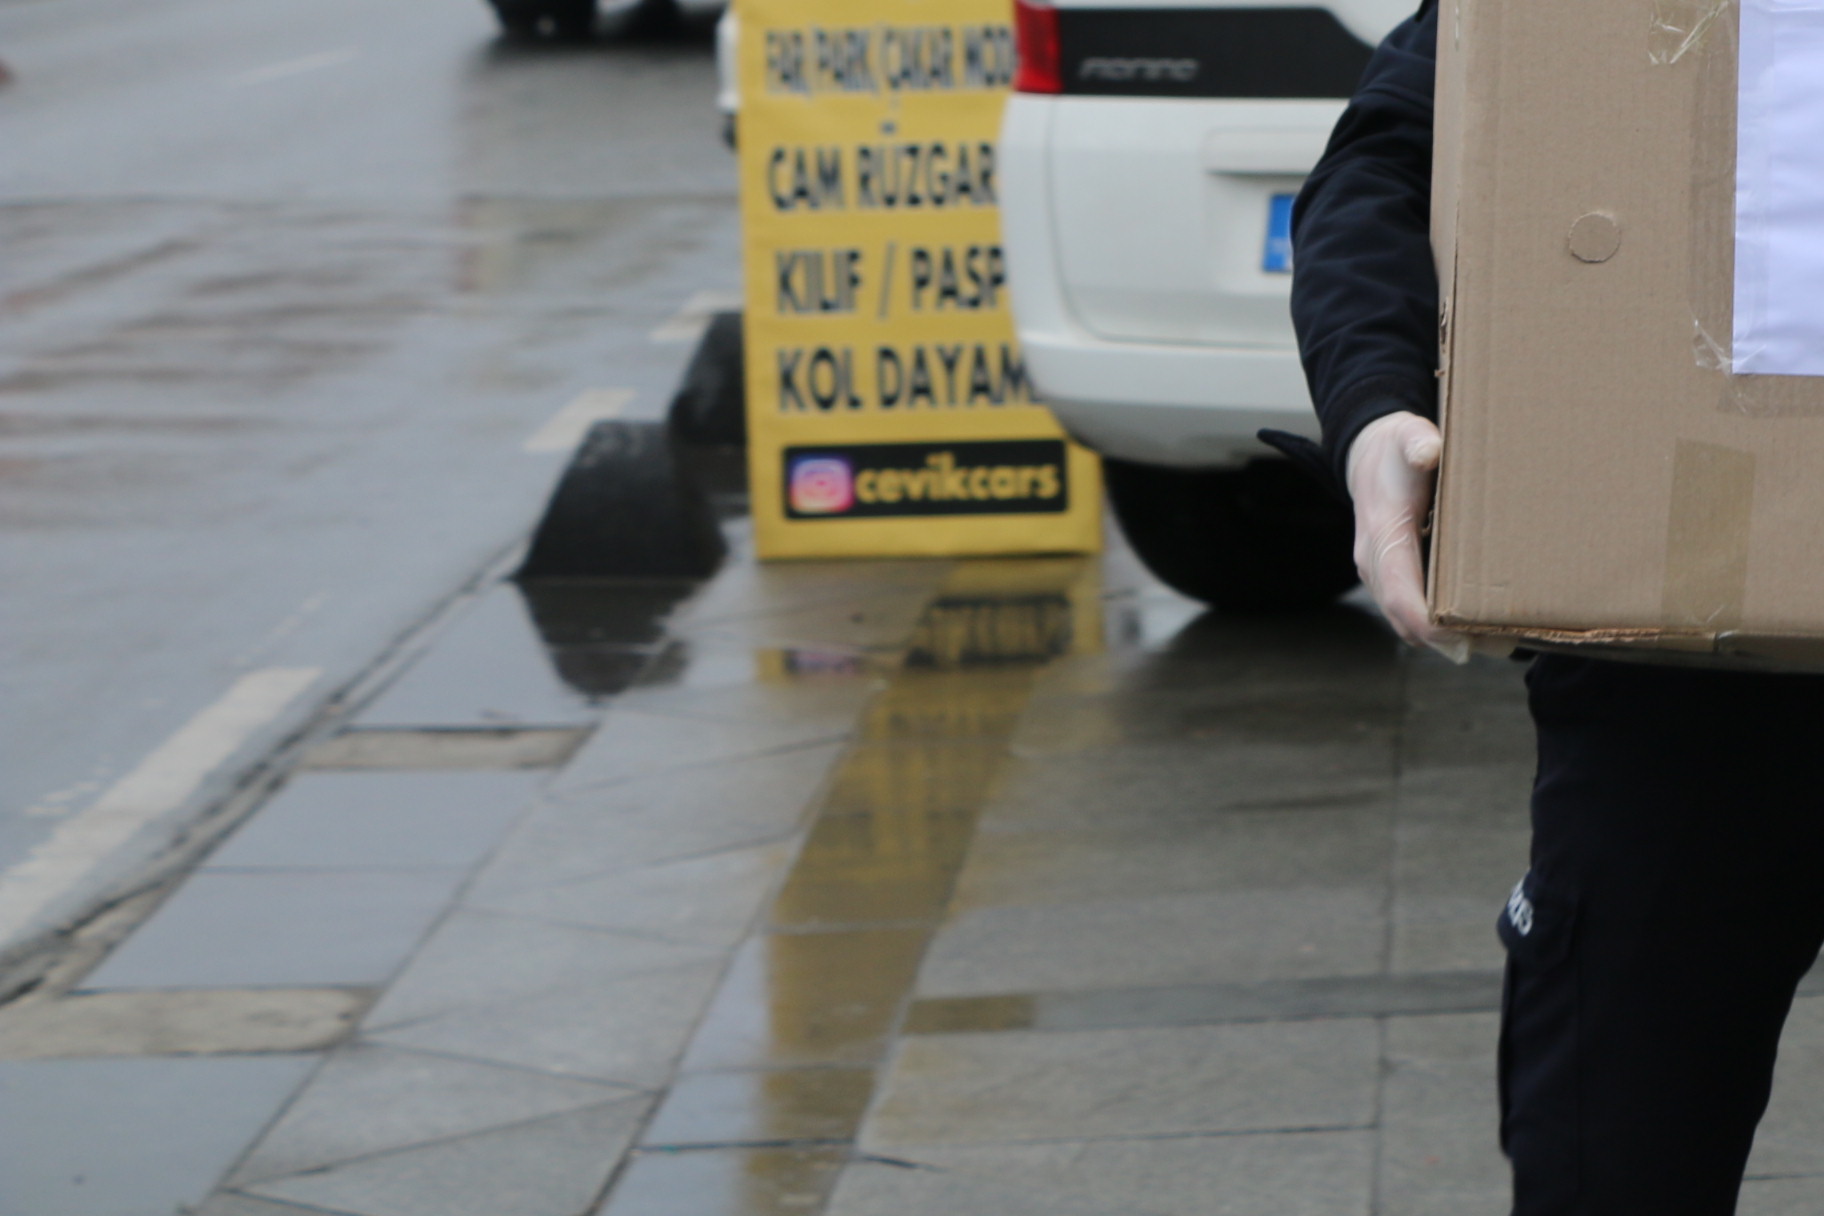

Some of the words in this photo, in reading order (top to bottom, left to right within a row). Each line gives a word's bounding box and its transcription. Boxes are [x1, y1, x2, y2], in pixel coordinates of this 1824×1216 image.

[767, 145, 844, 212] CAM
[775, 248, 863, 315] KILIF
[776, 346, 863, 412] KOL
[854, 450, 1061, 504] cevikcars
